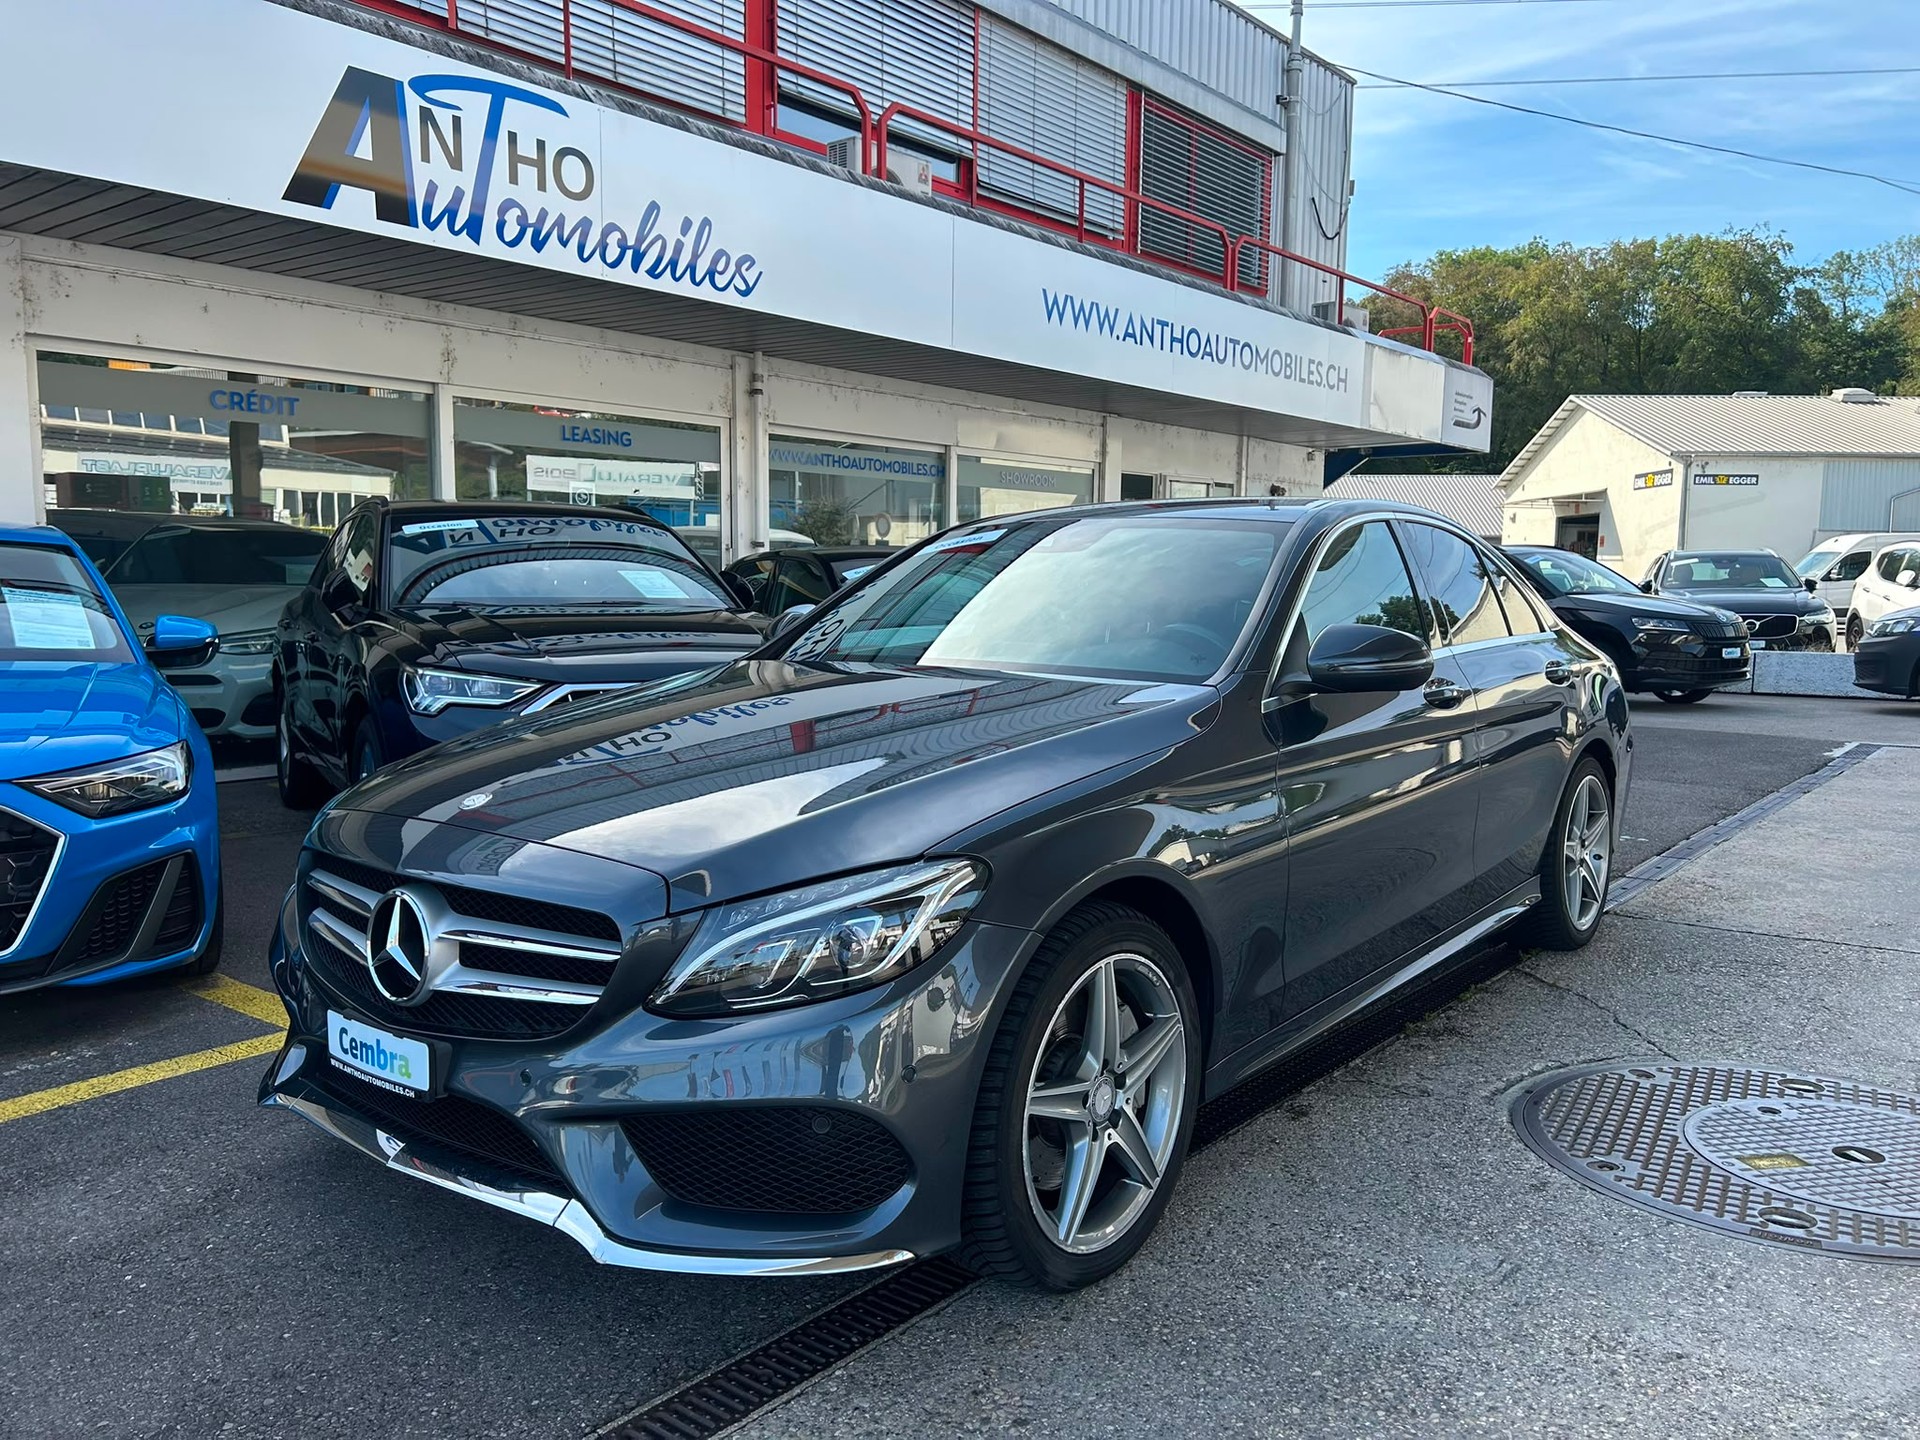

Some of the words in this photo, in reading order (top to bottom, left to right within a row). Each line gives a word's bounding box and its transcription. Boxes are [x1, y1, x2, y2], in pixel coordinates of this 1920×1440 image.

[1042, 288, 1348, 393] WWW.ANTHOAUTOMOBILES.CH
[209, 389, 300, 416] CRÉDIT
[562, 425, 632, 447] LEASING
[1000, 471, 1057, 488] SHOWROOM
[1695, 475, 1715, 484] EMIL
[1728, 476, 1758, 485] EGGER
[339, 1026, 412, 1079] Cembra
[330, 1058, 415, 1098] WWW.ANTHOAUTOMOBILES.CH
